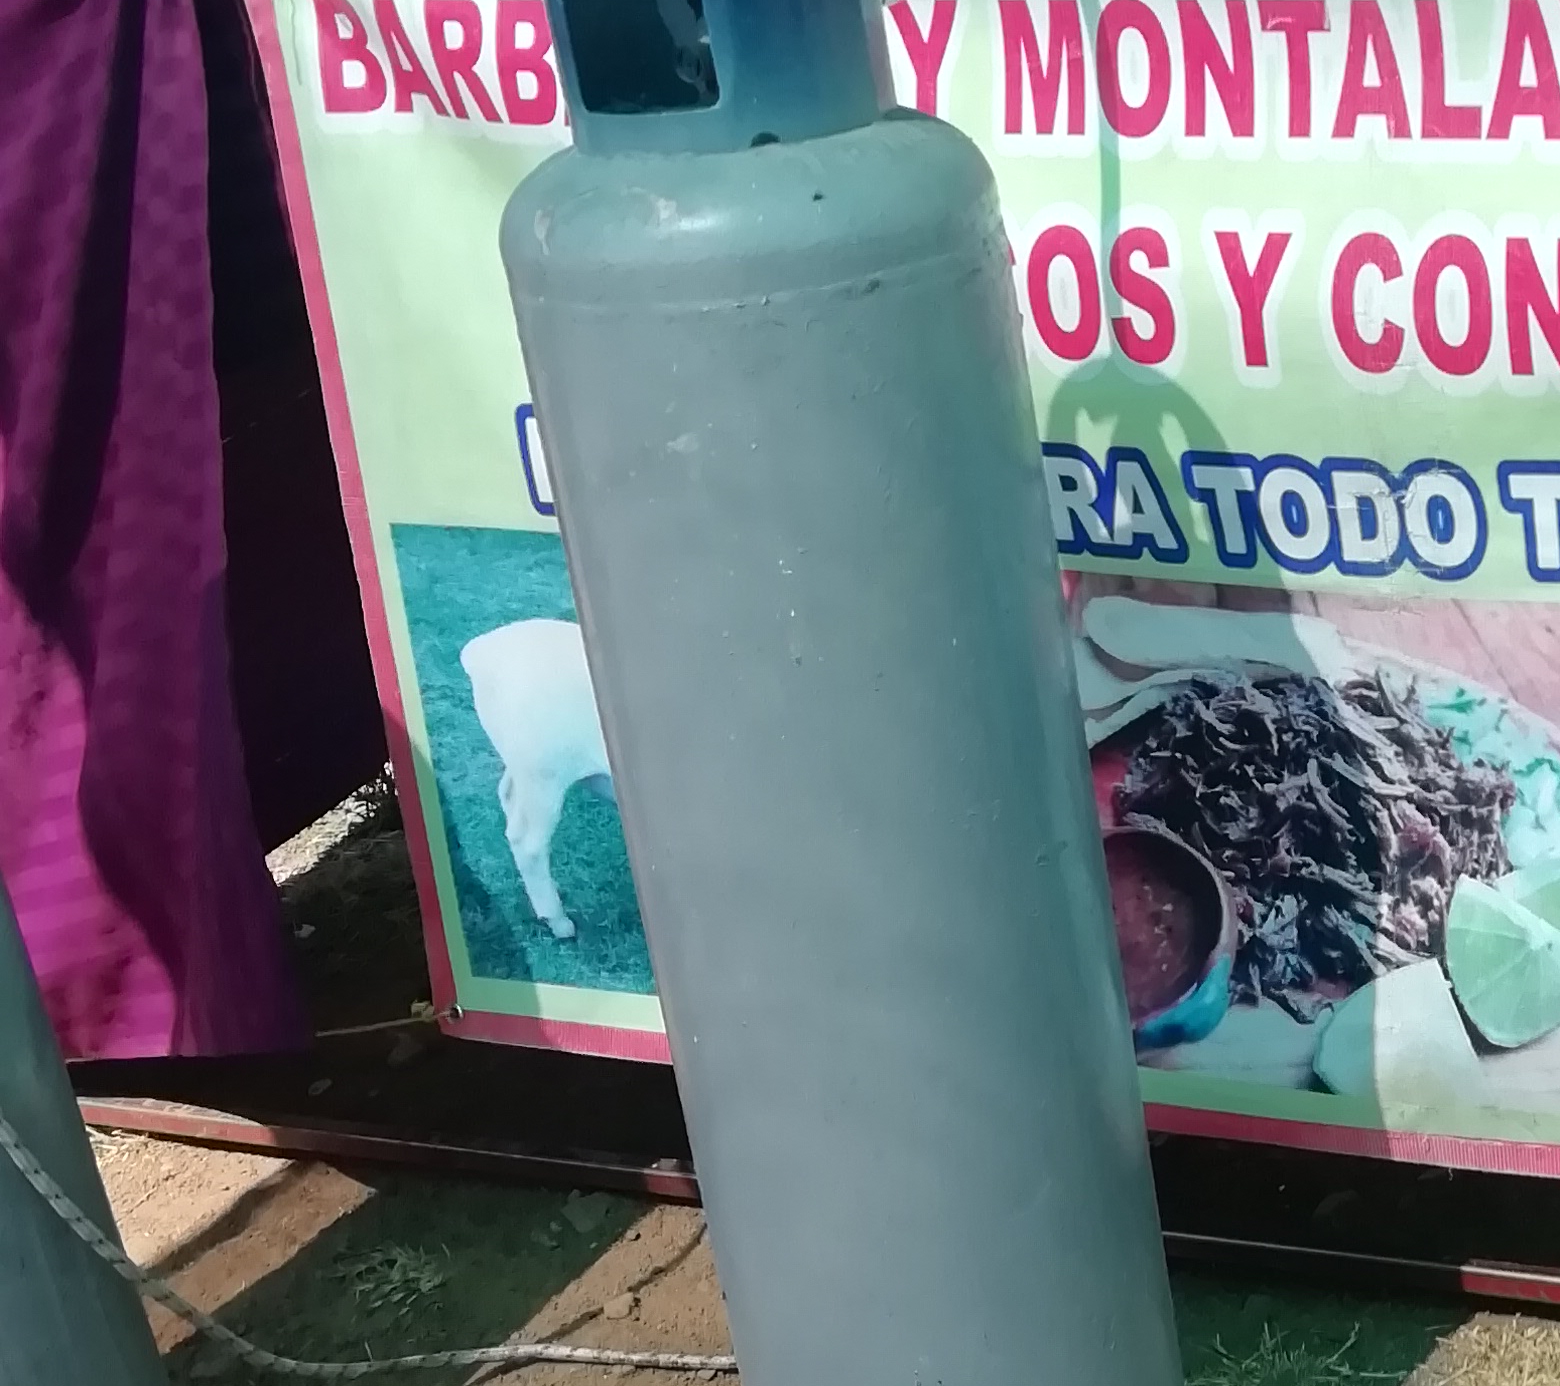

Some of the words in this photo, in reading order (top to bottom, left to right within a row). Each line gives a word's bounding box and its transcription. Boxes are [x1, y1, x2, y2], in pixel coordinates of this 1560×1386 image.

[1008, 224, 1176, 365] OS
[1214, 231, 1292, 367] Y
[1042, 442, 1189, 563] RA
[1181, 450, 1487, 581] TODO
